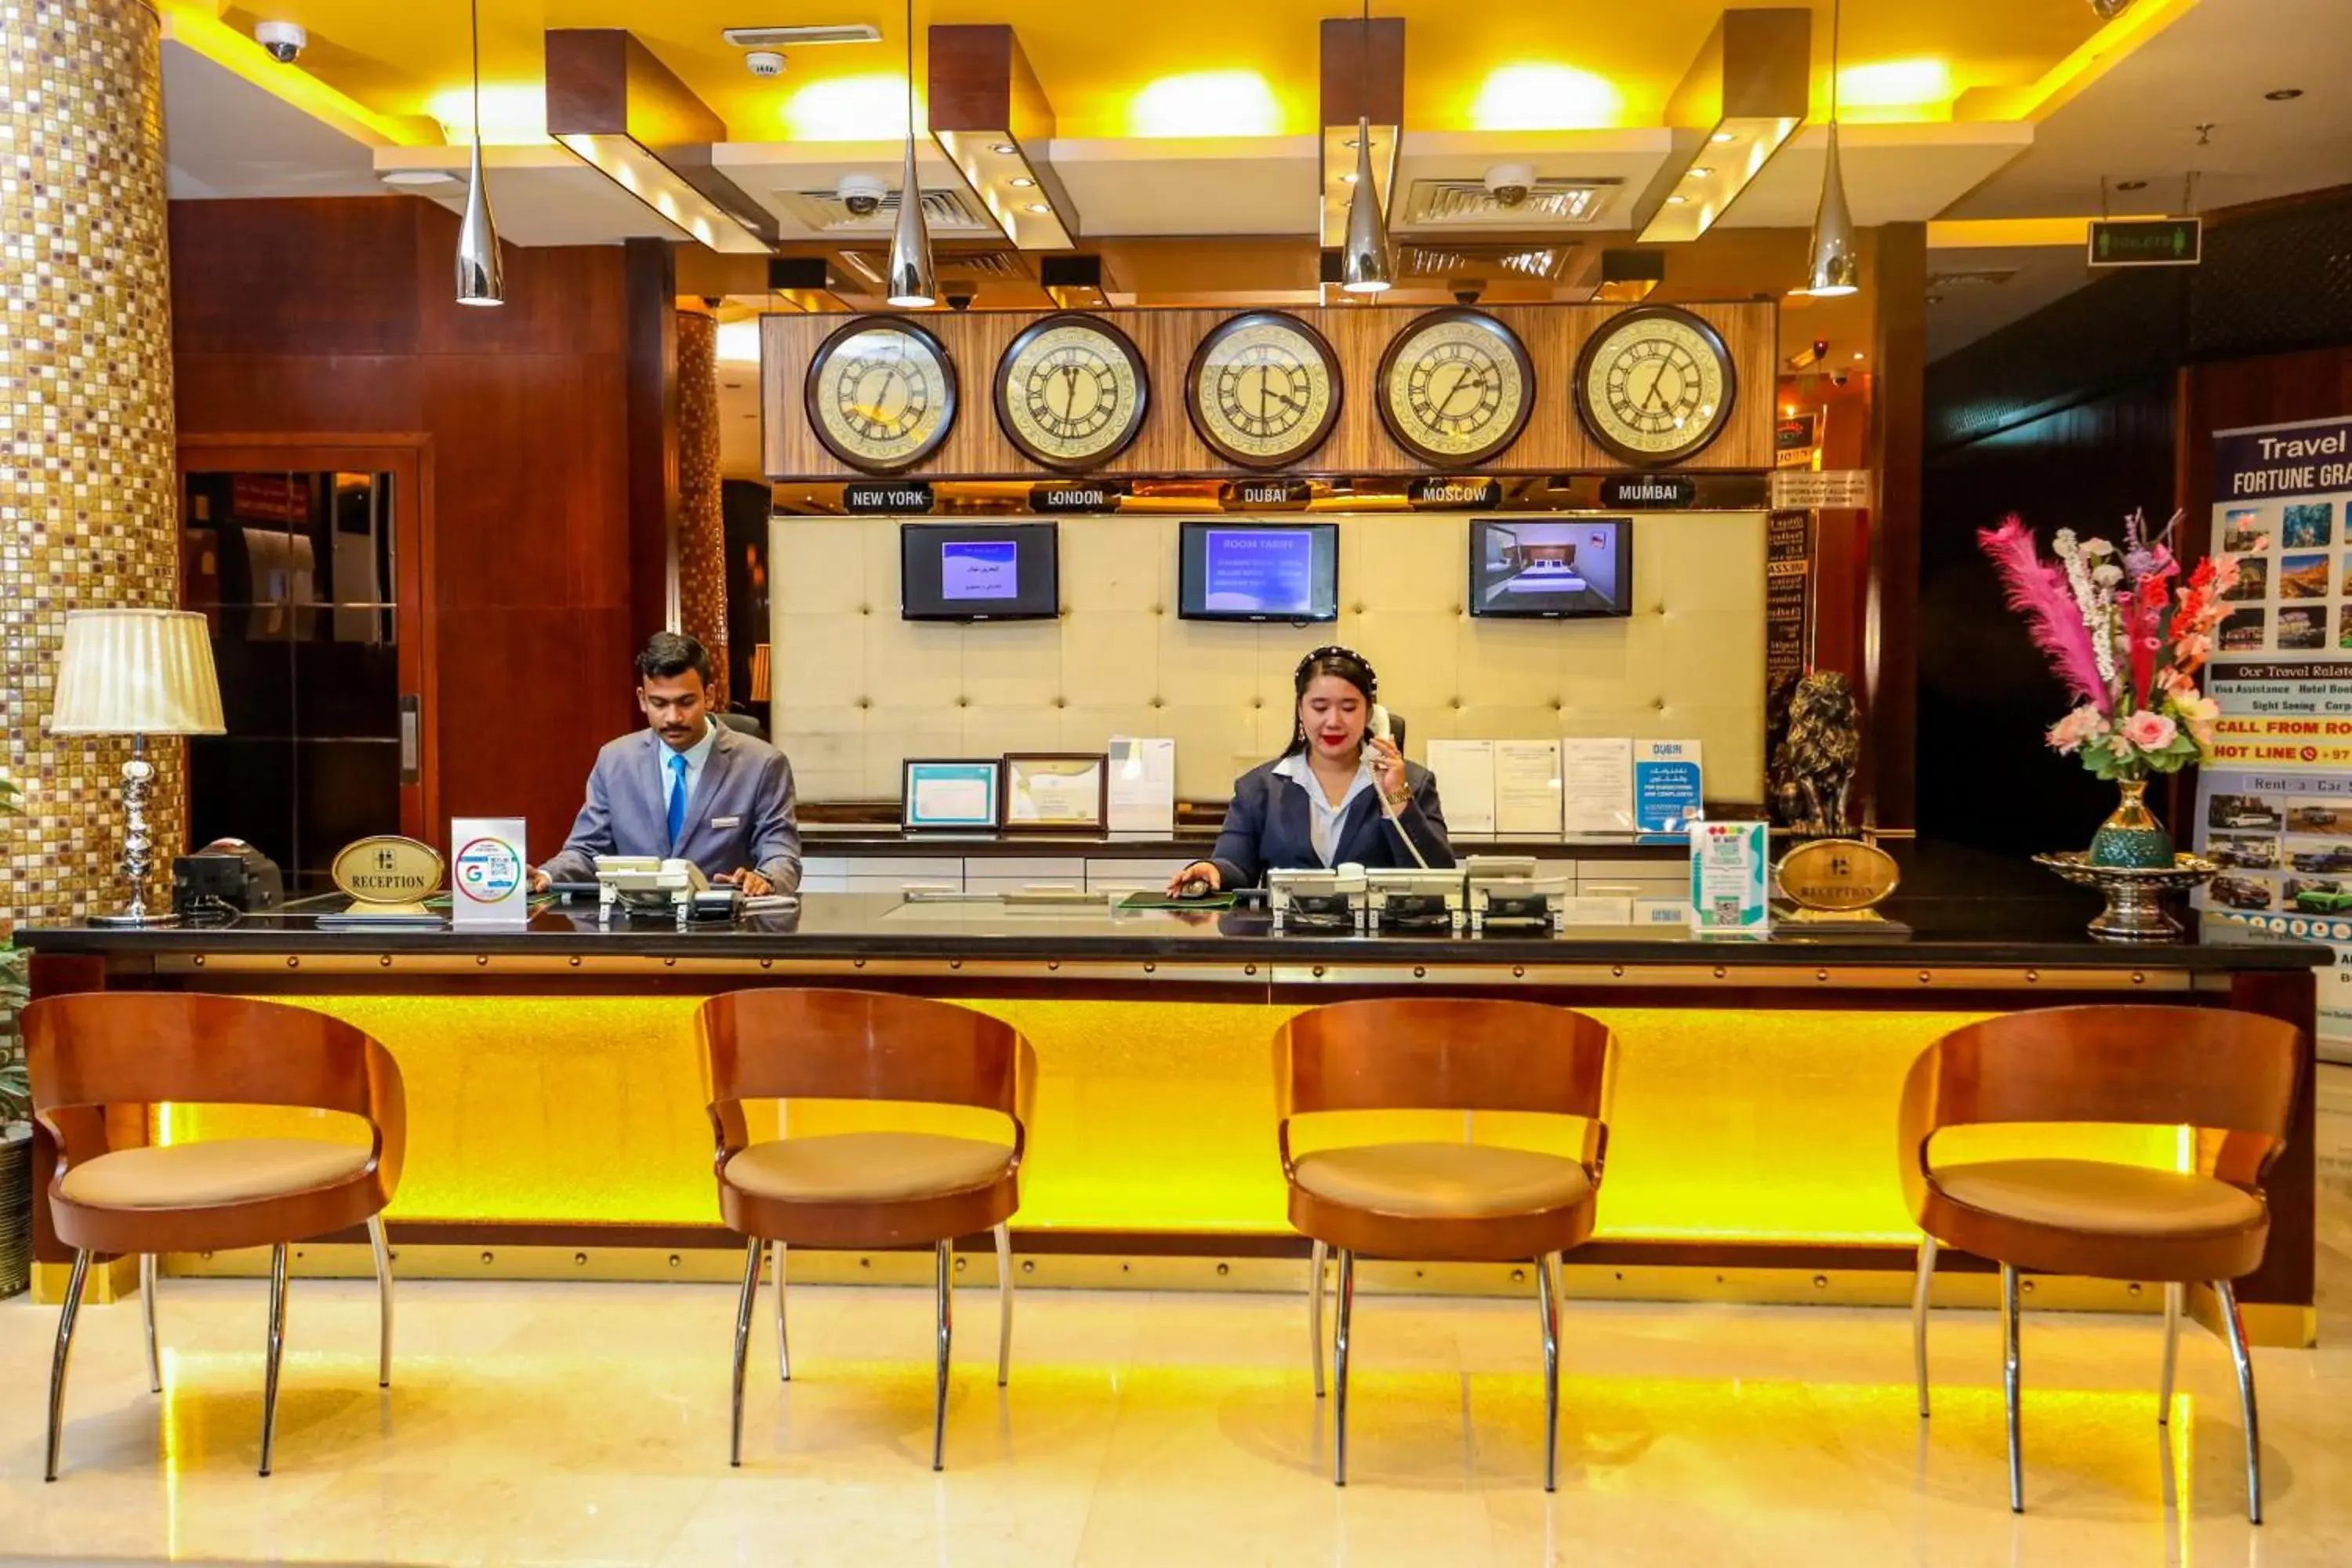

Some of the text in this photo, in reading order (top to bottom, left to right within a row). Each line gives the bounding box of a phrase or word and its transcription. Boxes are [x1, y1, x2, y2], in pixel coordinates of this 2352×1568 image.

[2258, 430, 2347, 460] Travel
[2233, 466, 2315, 494] FORTUNE
[853, 491, 924, 506] NEW YORK
[1048, 491, 1103, 505] LONDON
[1244, 488, 1287, 503] DUBAI
[1423, 487, 1487, 502] MOSCOW
[1619, 485, 1677, 499] MUMBAI
[2239, 666, 2263, 677] Our
[2268, 666, 2310, 677] Travel
[2215, 721, 2352, 735] CALL FROM RO
[2214, 746, 2249, 757] HOT
[2255, 746, 2296, 758] LINE
[2255, 779, 2286, 790] Rent
[352, 875, 425, 888] RECEPTION
[1800, 885, 1875, 898] RECEPTION
